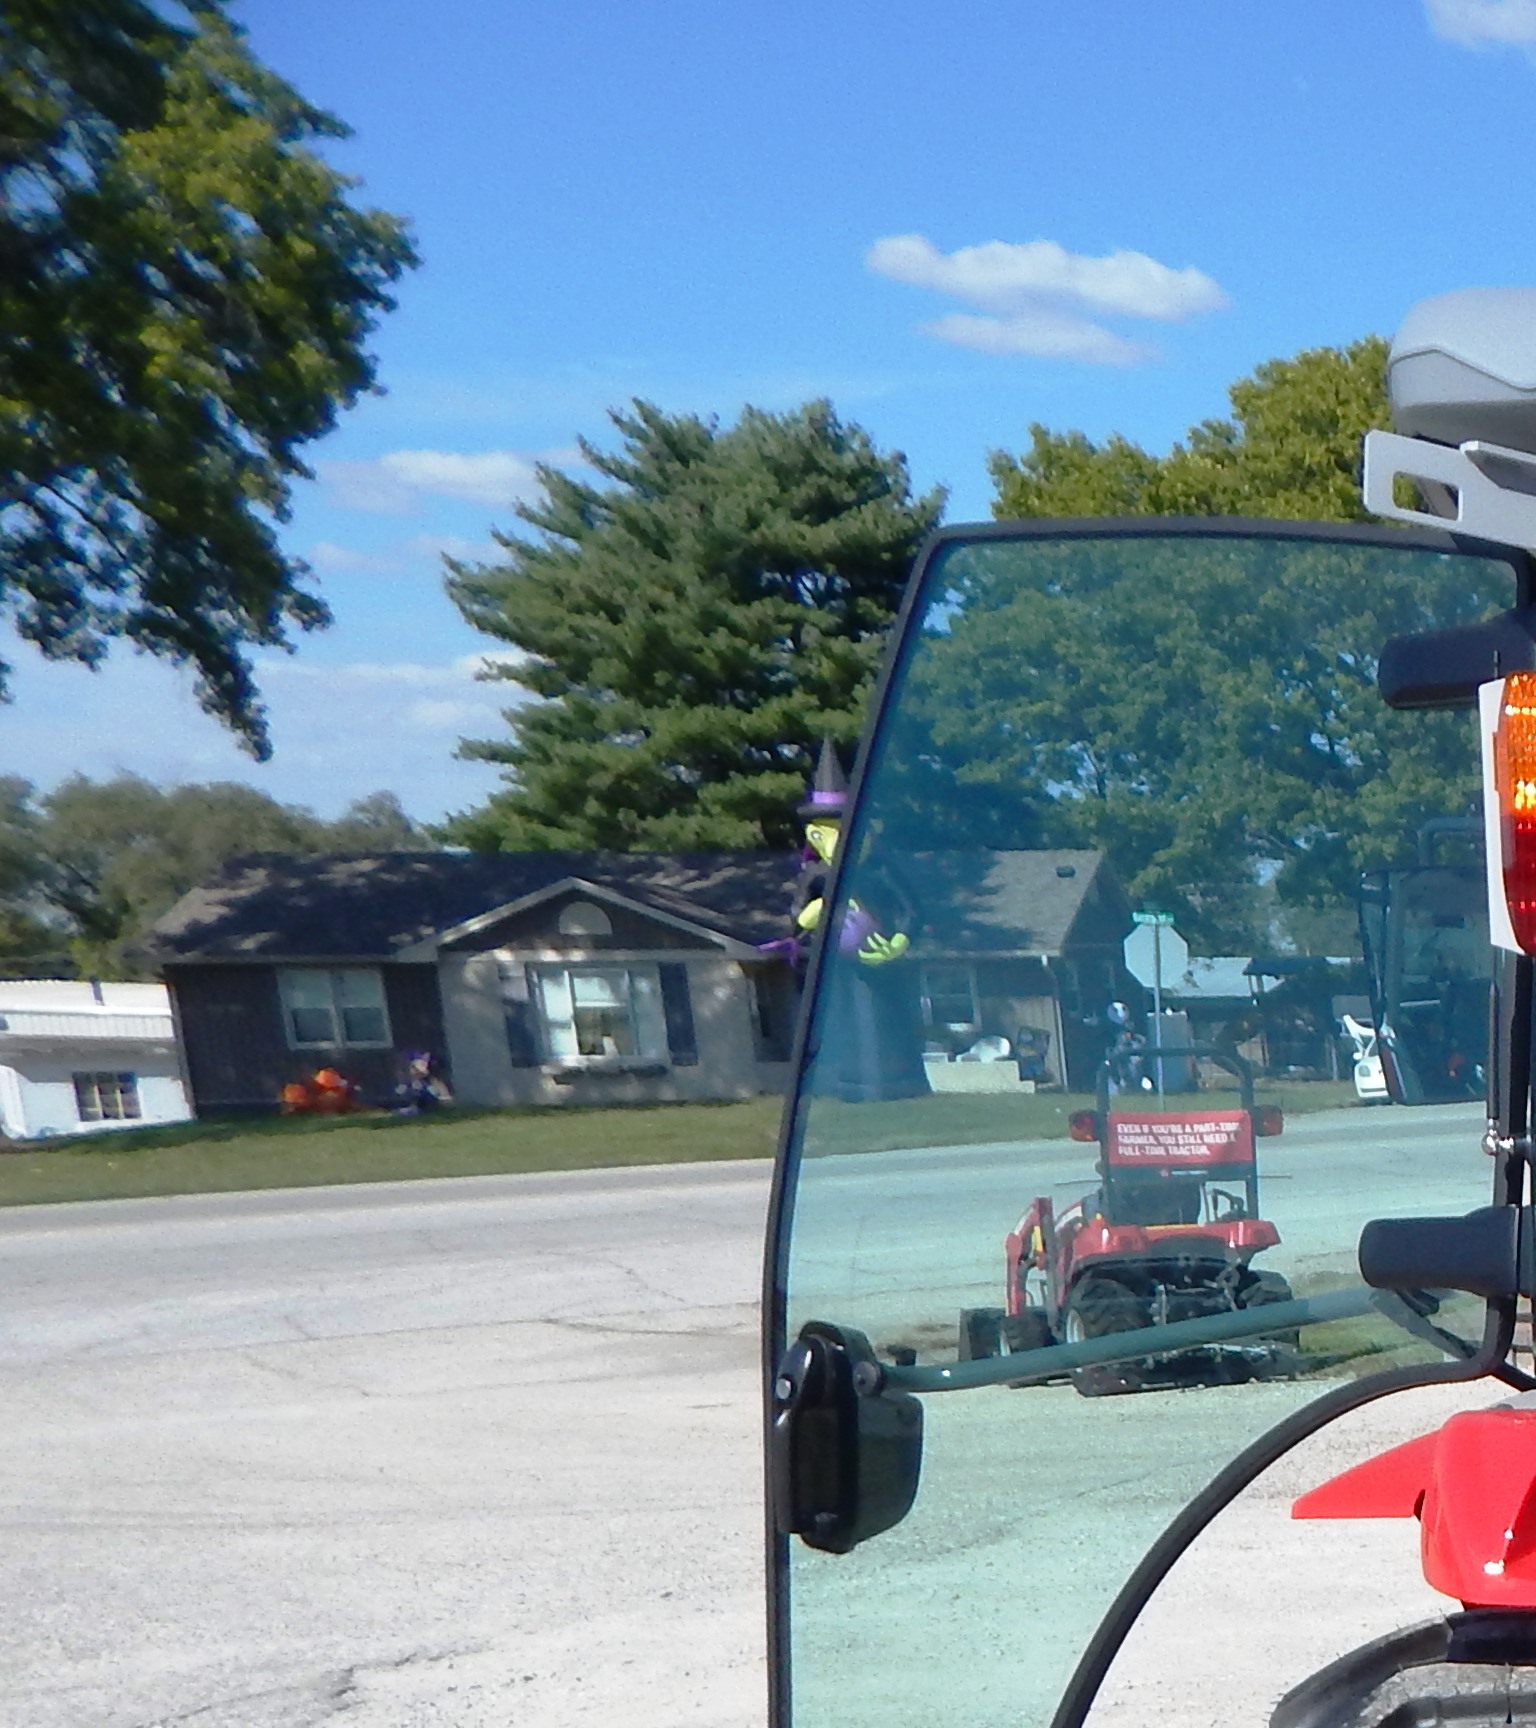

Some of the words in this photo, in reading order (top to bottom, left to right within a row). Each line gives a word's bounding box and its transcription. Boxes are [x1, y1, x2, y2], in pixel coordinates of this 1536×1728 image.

[1117, 1123, 1141, 1134] EVEN
[1185, 1123, 1192, 1133] A
[1158, 1135, 1176, 1144] YOU
[1177, 1134, 1202, 1145] STILL
[1203, 1133, 1228, 1144] NEED
